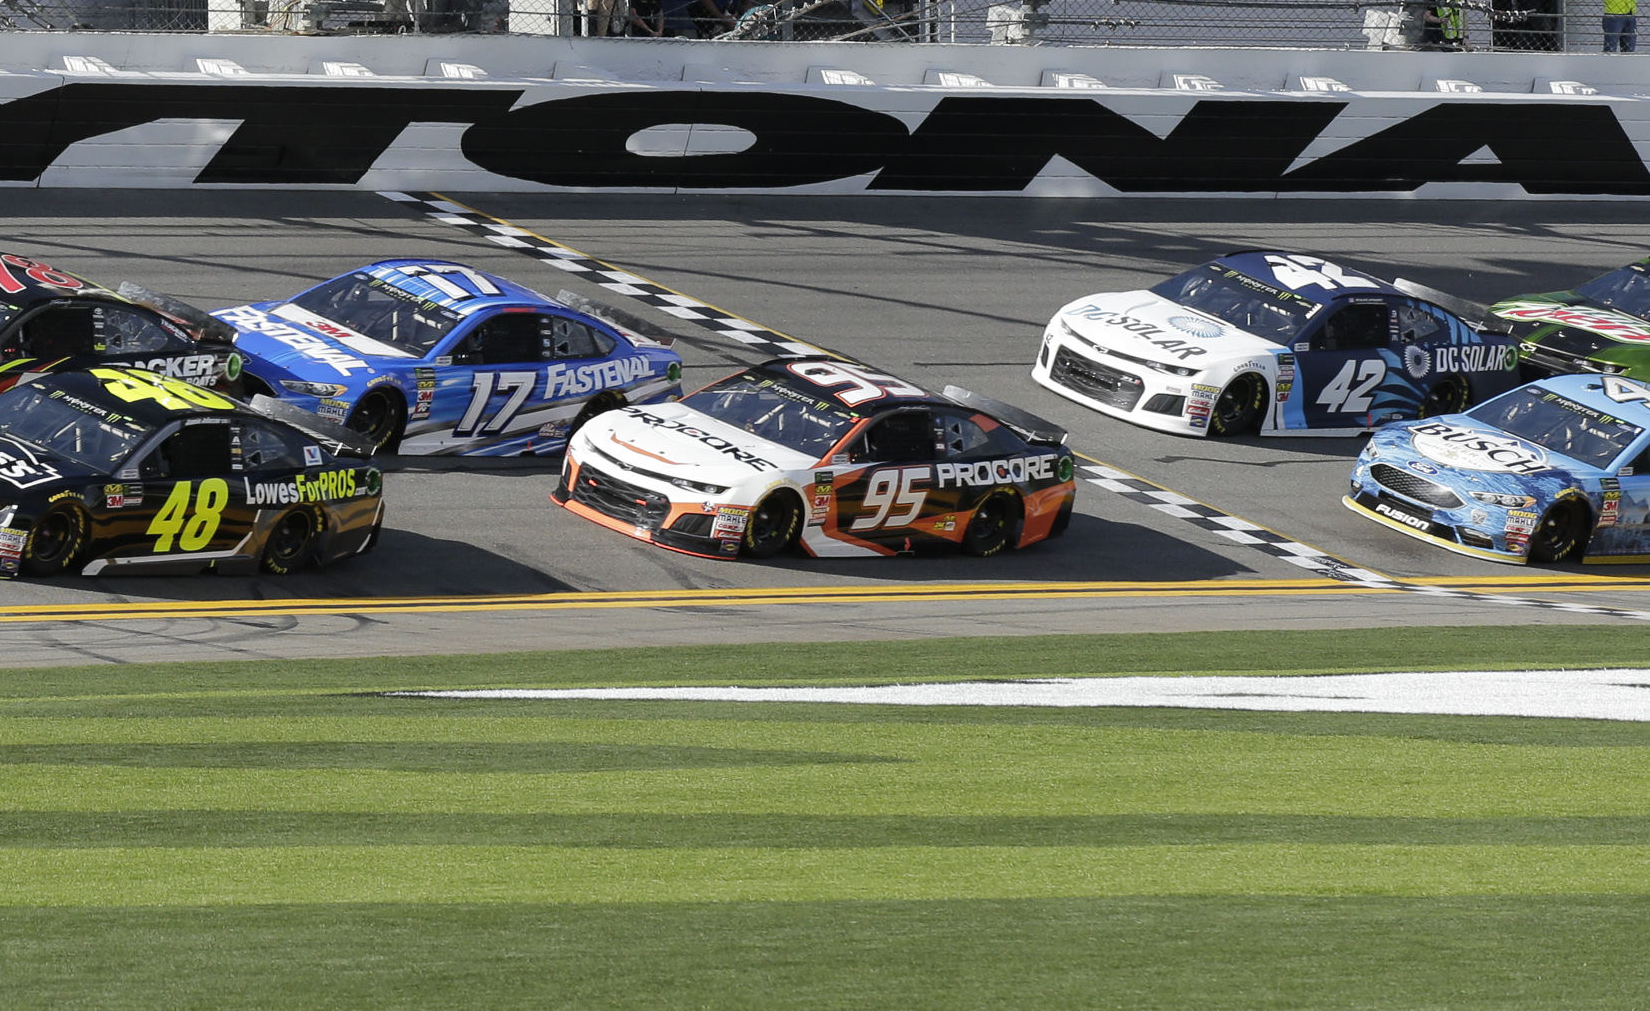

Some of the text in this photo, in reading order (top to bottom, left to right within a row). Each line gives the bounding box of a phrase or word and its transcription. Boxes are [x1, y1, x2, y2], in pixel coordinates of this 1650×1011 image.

[394, 263, 501, 301] 17
[1262, 254, 1382, 291] 42
[208, 305, 370, 378] FASTENAL
[306, 318, 353, 339] 3M
[1106, 313, 1208, 361] SOLAR
[1233, 360, 1267, 373] GOODYEAR
[1435, 344, 1506, 373] DC SOLAR
[89, 368, 236, 410] 48
[543, 354, 656, 400] FASTENAL
[786, 360, 930, 408] 95
[1315, 358, 1387, 413] 42
[319, 398, 350, 410] MOOG
[418, 391, 433, 401] 3M
[453, 370, 537, 438] 17
[1191, 391, 1218, 401] MAHLE
[1278, 392, 1290, 402] 3M
[317, 406, 348, 417] MAHLE
[618, 405, 780, 472] PROCORE
[1415, 423, 1548, 473] BUSCH
[936, 454, 1054, 488] PROCORE
[107, 496, 122, 507] 3M
[718, 506, 749, 517] MOOG
[815, 496, 829, 507] 3M
[850, 464, 933, 531] 95
[1603, 500, 1618, 511] 3M
[145, 478, 228, 553] 48
[717, 514, 746, 524] MAHLE
[1375, 503, 1430, 531] FUSION
[1506, 517, 1536, 527] MAHLE
[1507, 509, 1539, 519] MOOG
